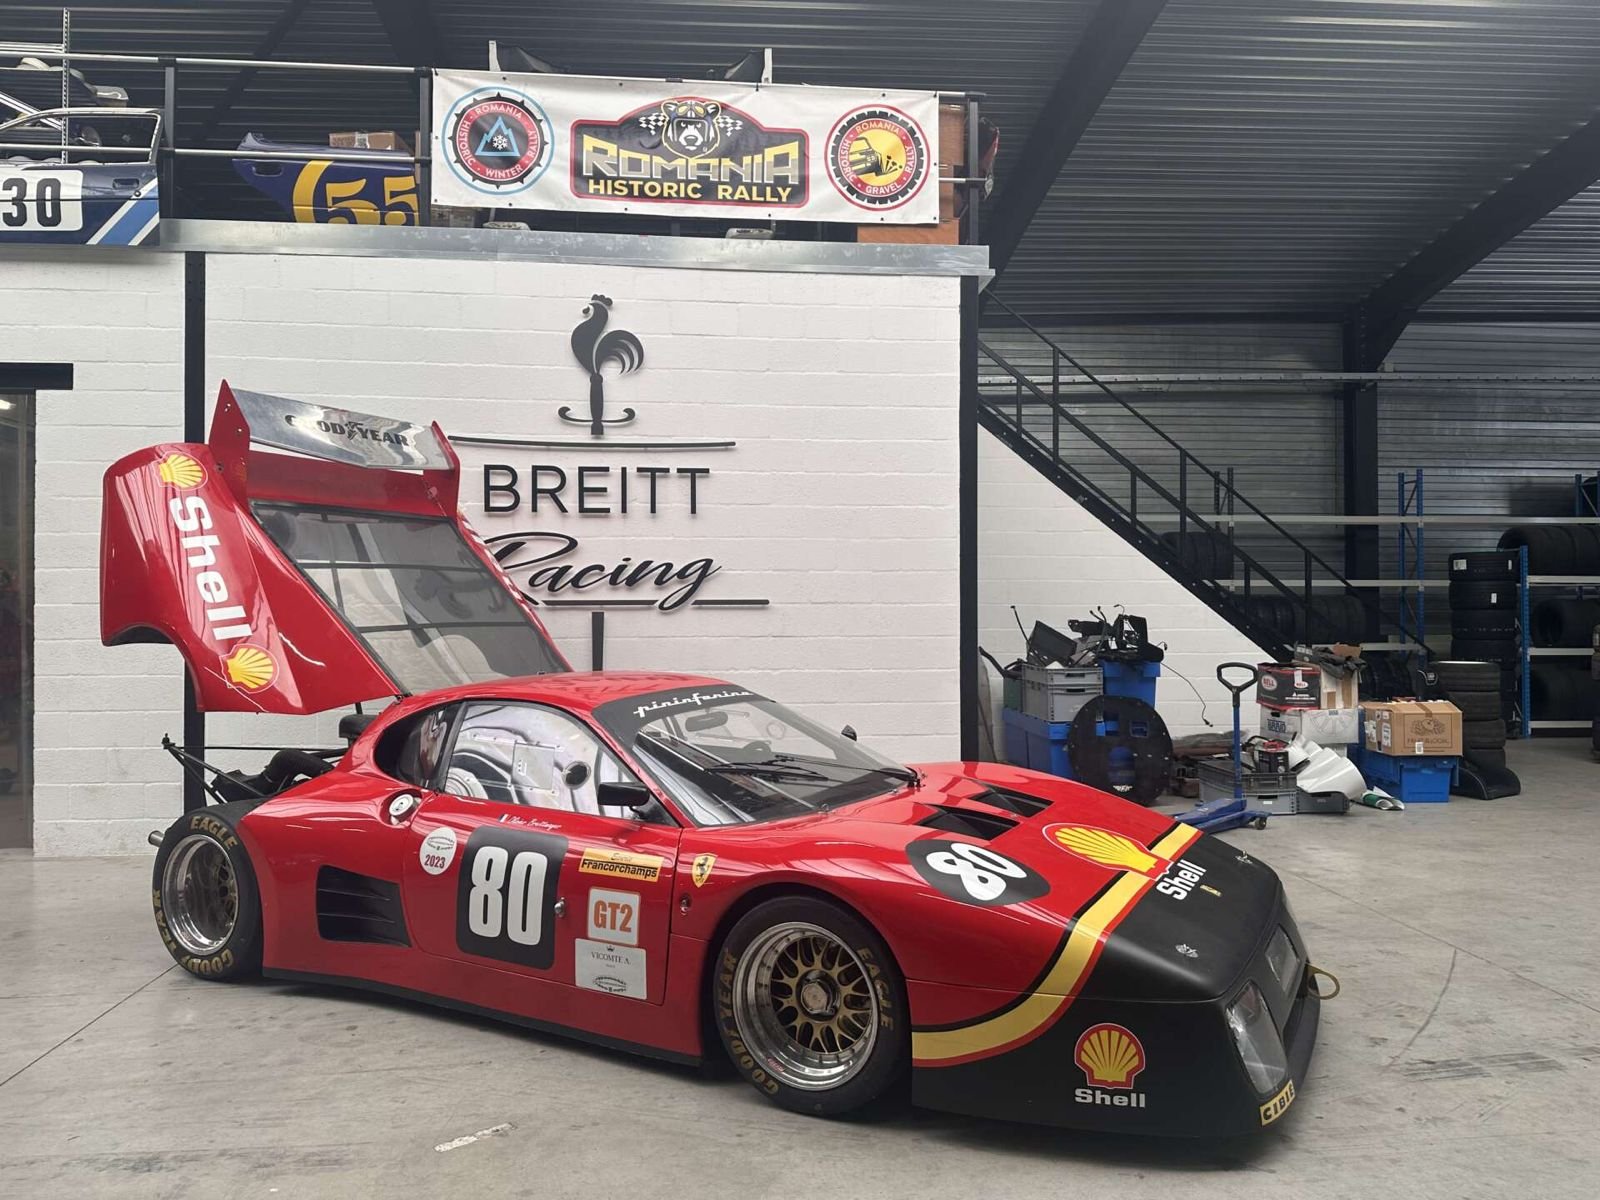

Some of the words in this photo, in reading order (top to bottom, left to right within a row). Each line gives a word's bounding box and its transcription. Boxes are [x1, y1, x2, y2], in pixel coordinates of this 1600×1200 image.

[475, 104, 523, 119] ROMANIA
[855, 121, 901, 135] ROMANIA
[459, 119, 477, 166] HISTORIC
[527, 129, 539, 159] RALLY
[581, 133, 800, 186] ROMANIA
[839, 137, 858, 182] HISTORIC
[904, 144, 915, 174] RALLY
[485, 163, 523, 179] WINTER
[2, 178, 62, 227] 30
[588, 178, 702, 199] HISTORIC
[717, 184, 792, 203] RALLY
[865, 182, 902, 196] GRAVEL
[483, 464, 711, 515] BREITT
[169, 496, 253, 641] Shell
[190, 815, 239, 850] EAGLE
[424, 854, 446, 869] 2023
[581, 859, 659, 879] Francorchamps
[926, 842, 1028, 901] 80
[468, 845, 549, 946] 80
[1156, 859, 1207, 900] Shell
[593, 899, 634, 933] GT2
[1074, 1087, 1147, 1109] Shell
